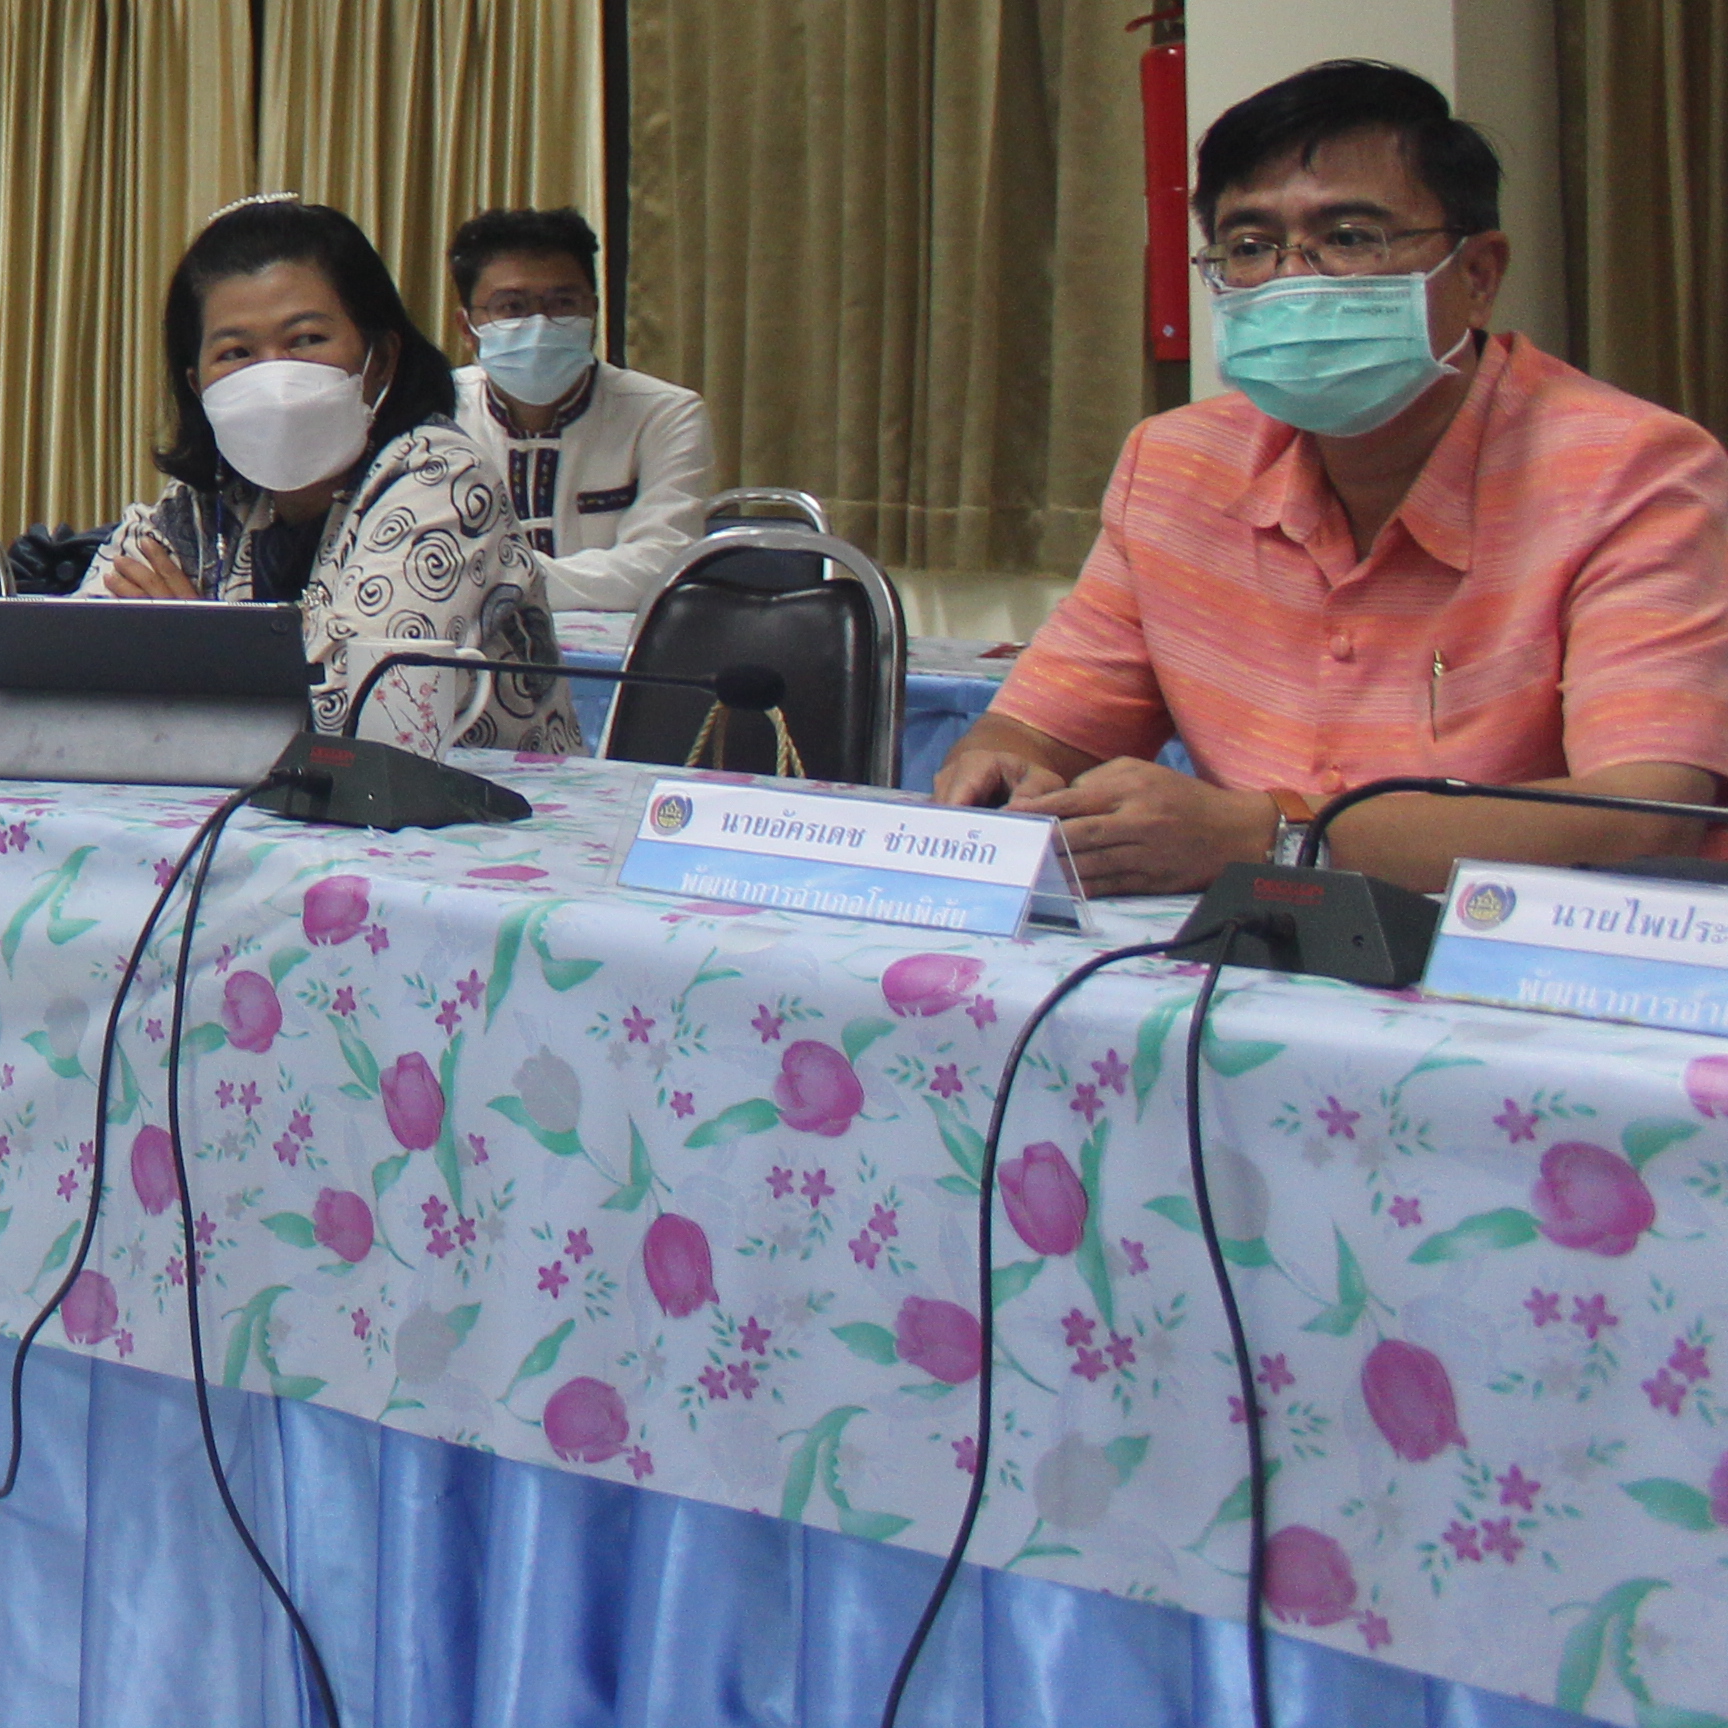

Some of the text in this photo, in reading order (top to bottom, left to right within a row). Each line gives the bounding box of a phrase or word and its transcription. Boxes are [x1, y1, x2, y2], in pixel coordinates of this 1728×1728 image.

[721, 809, 998, 865] นายอัครเดช ช่างเหล็ก
